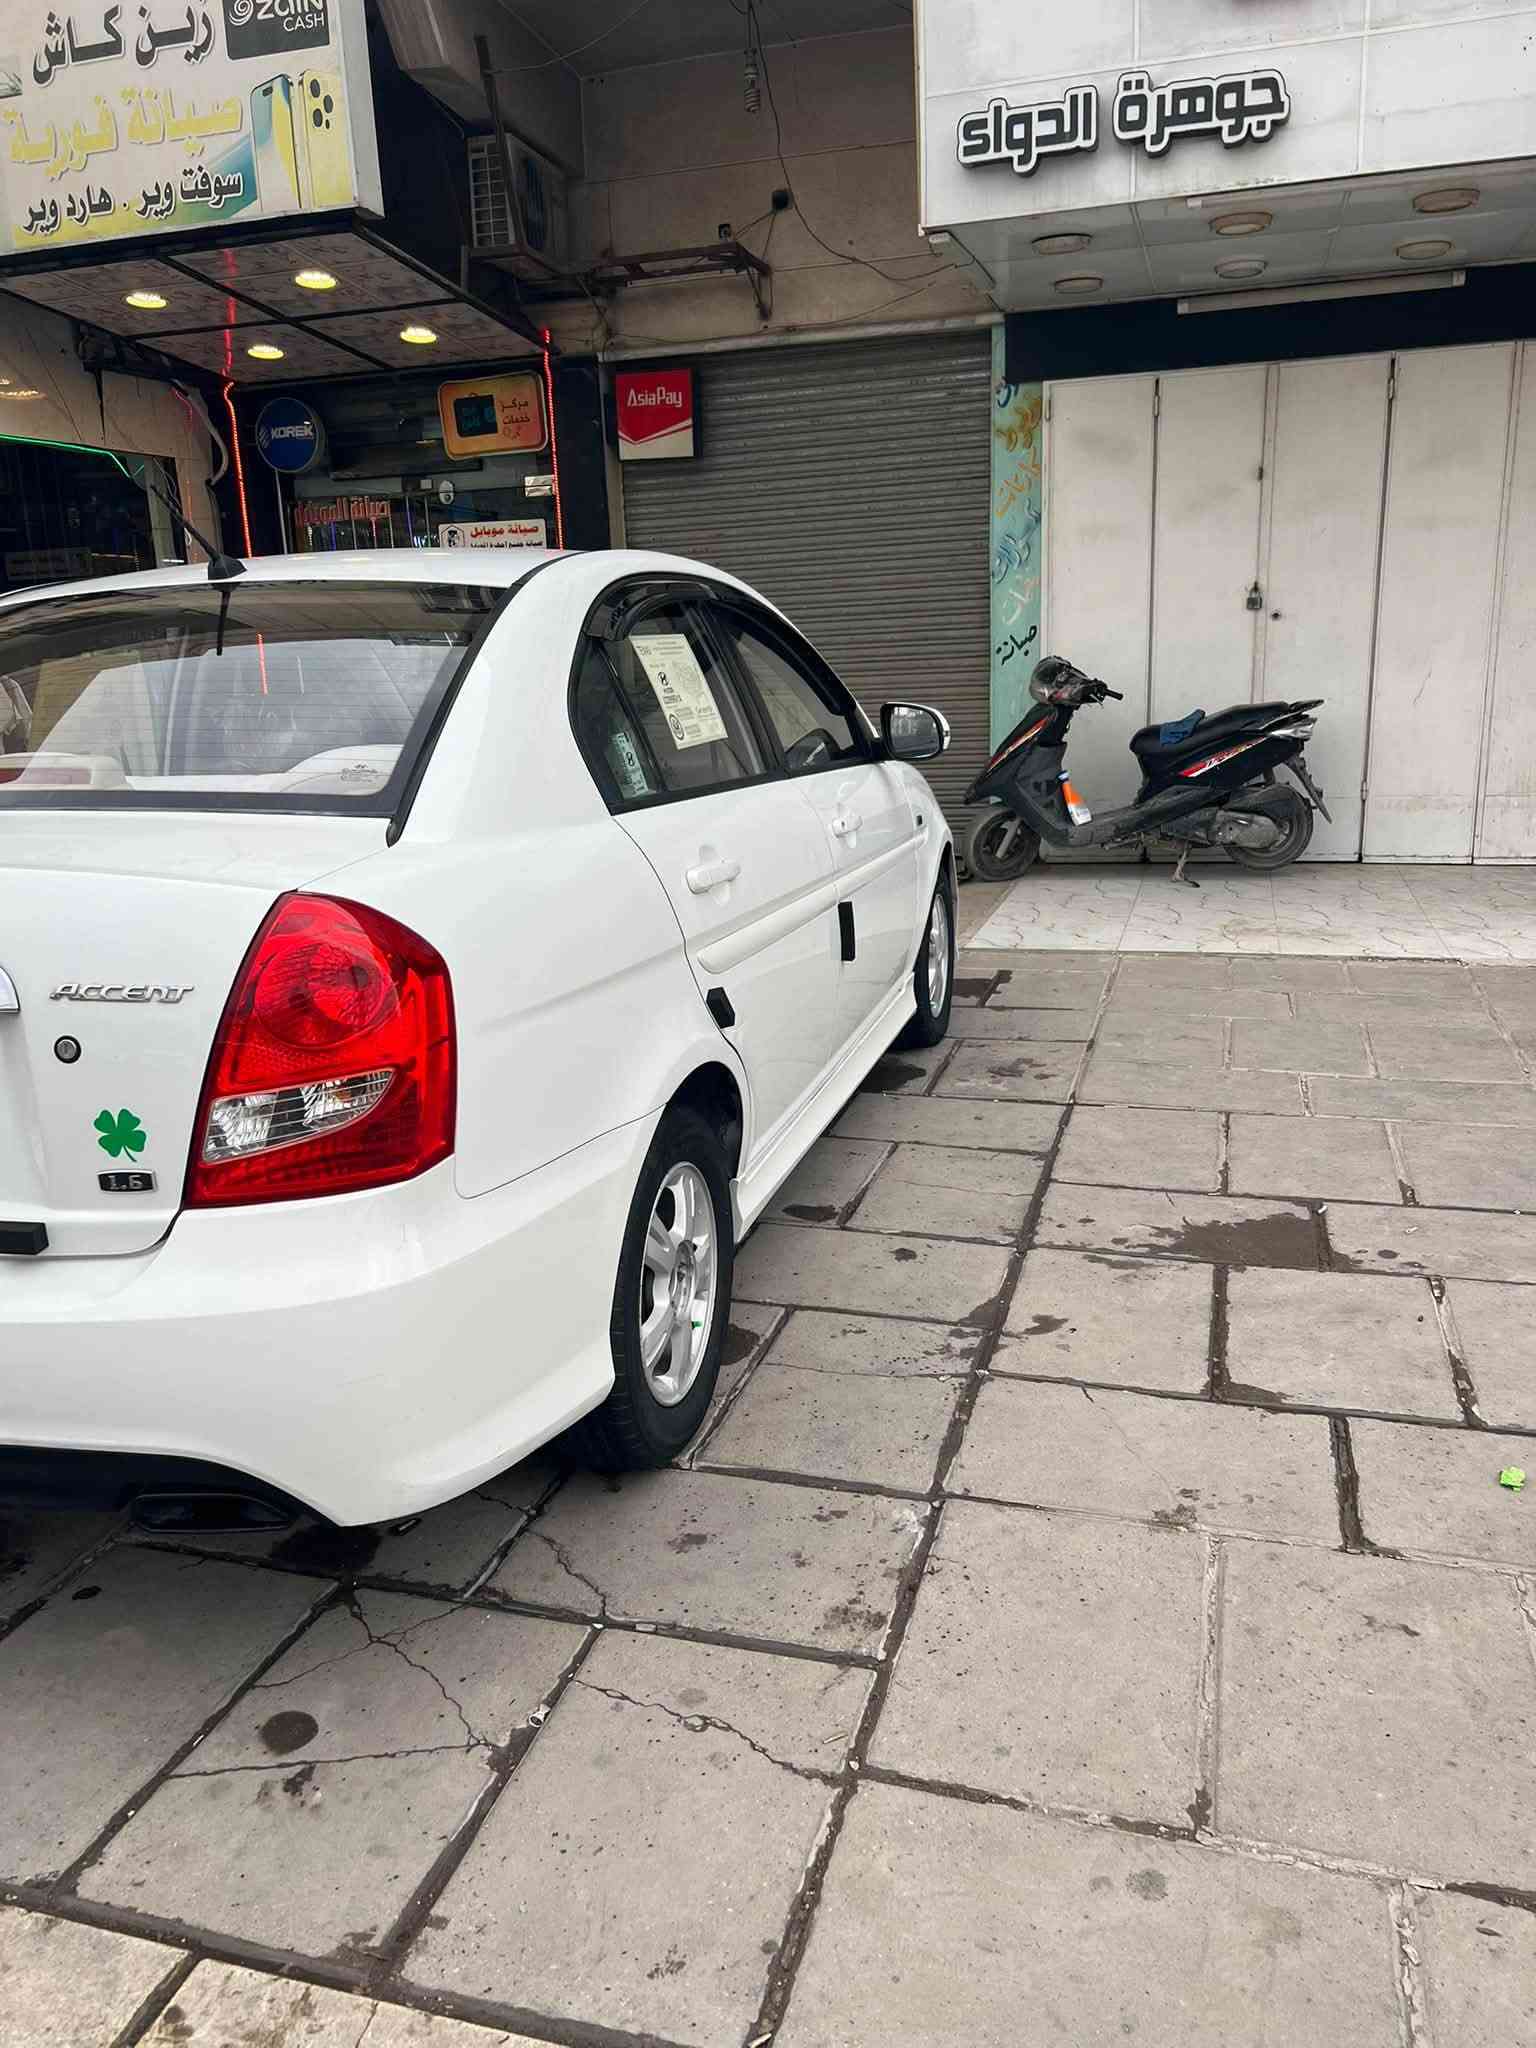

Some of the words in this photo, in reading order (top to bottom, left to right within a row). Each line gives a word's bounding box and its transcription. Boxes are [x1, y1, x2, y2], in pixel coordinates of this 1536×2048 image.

[283, 13, 325, 32] CASH
[34, 3, 122, 83] كاش
[121, 87, 243, 157] صيانة
[960, 90, 1095, 170] الدواء
[1116, 74, 1288, 154] جوهرة
[3, 95, 118, 182] فورية
[65, 185, 114, 225] هارد
[136, 180, 175, 219] وير
[179, 164, 243, 207] سوفت
[23, 199, 60, 234] وير
[626, 386, 683, 408] AsiaPay
[271, 424, 313, 440] KOREK
[50, 983, 194, 1004] ACCENT
